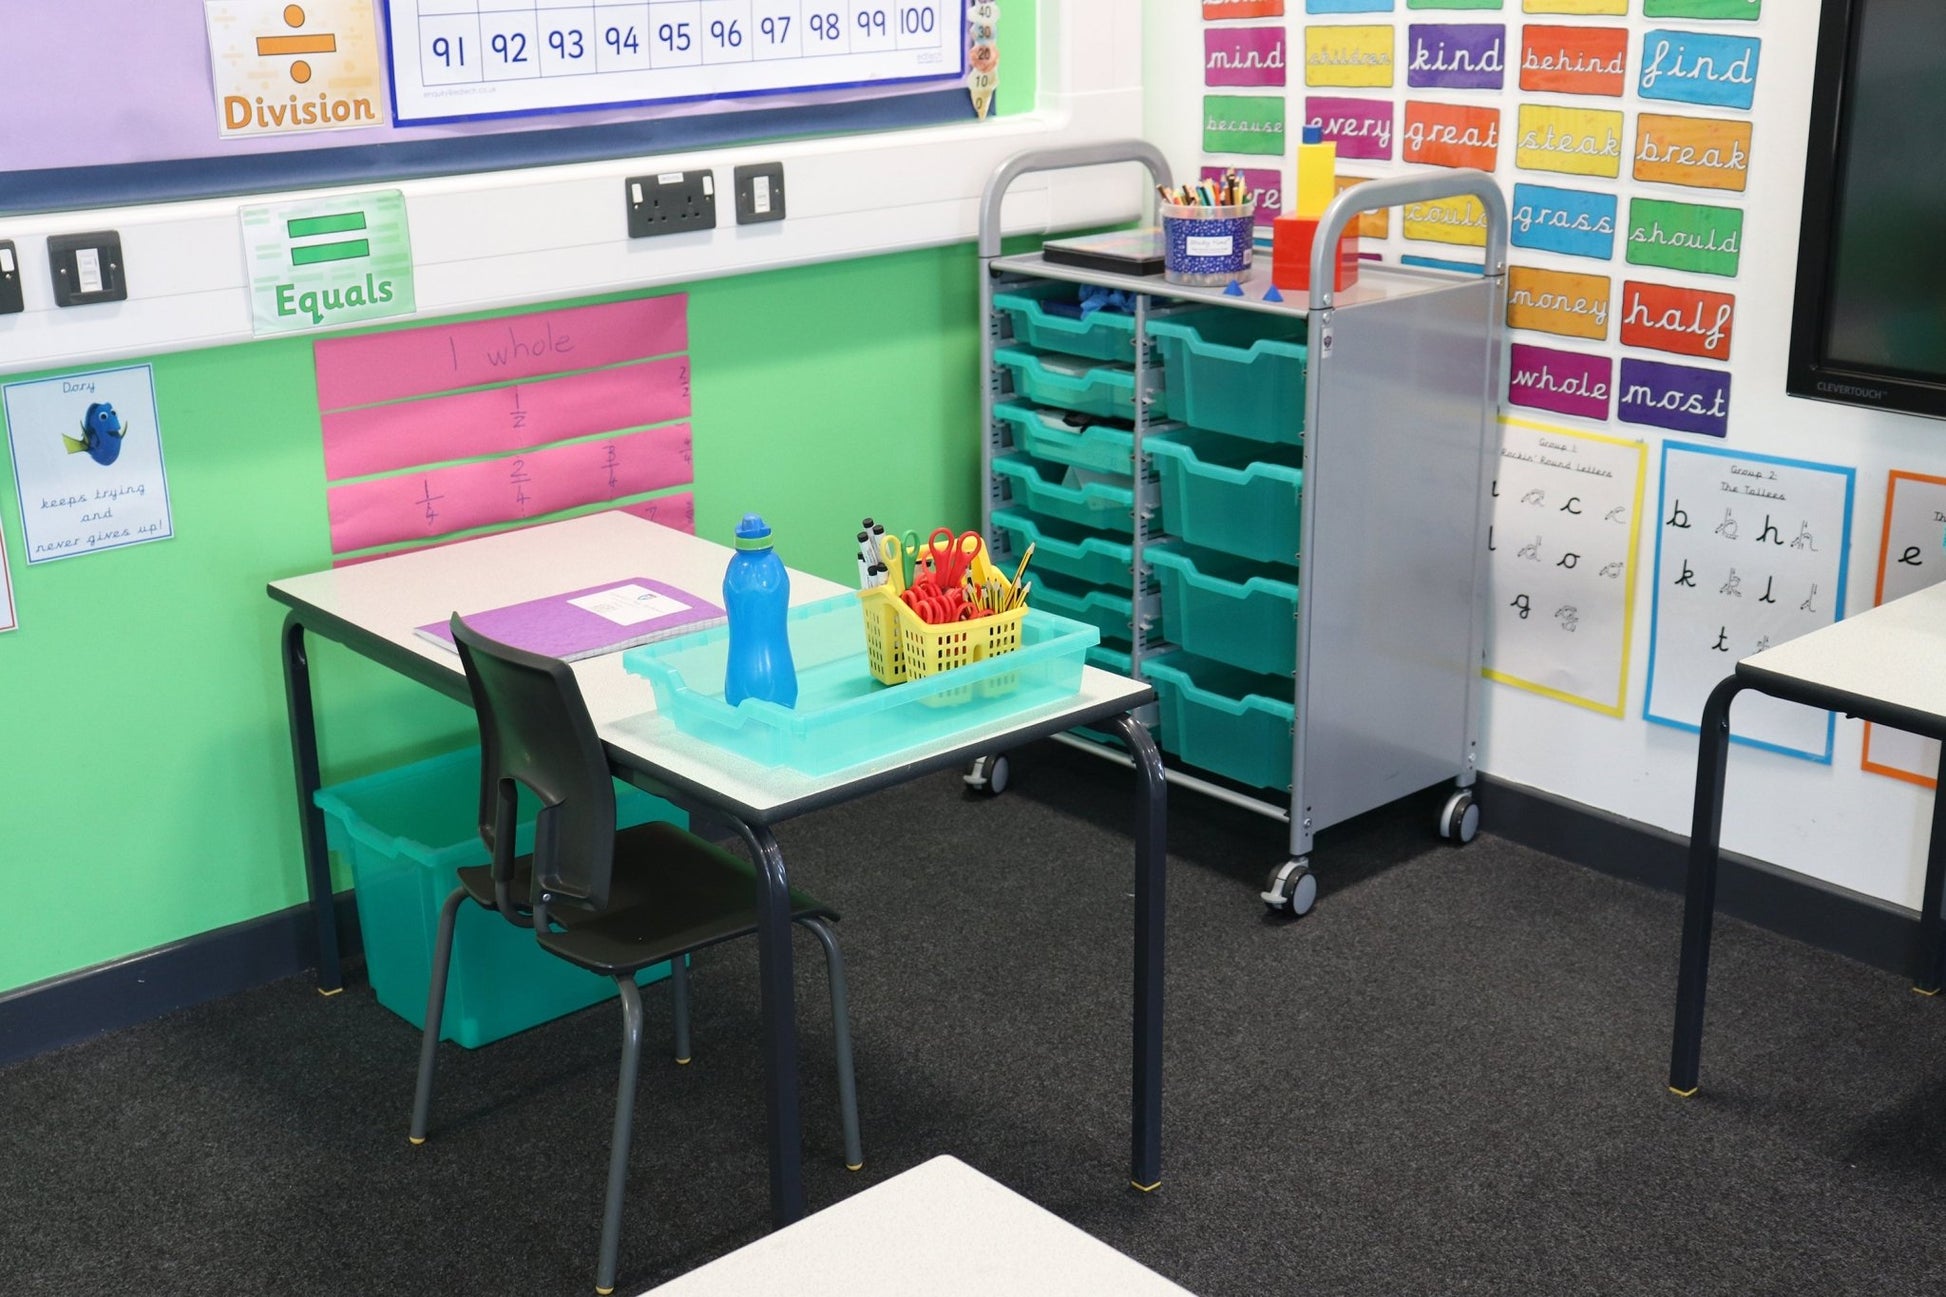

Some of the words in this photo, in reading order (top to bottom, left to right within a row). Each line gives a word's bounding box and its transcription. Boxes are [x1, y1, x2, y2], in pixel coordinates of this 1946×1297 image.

[978, 6, 992, 18] 40
[433, 37, 464, 67] 91
[491, 33, 528, 63] 92
[549, 30, 584, 59] 93
[605, 26, 639, 55] 94
[659, 23, 691, 51] 95
[711, 19, 742, 47] 96
[761, 16, 791, 43] 97
[810, 13, 840, 40] 98
[857, 10, 886, 37] 99
[900, 7, 935, 34] 100
[978, 26, 992, 38] 30
[978, 47, 991, 60] 20
[1206, 41, 1284, 69] mind
[1308, 47, 1391, 65] children
[1409, 37, 1504, 71] kind
[1521, 48, 1624, 75] behind
[1641, 40, 1753, 88] find
[976, 75, 989, 87] 10
[224, 92, 376, 131] Division
[1206, 115, 1284, 132] because
[1404, 121, 1498, 151] great
[1518, 124, 1620, 157] steak
[1636, 133, 1747, 170] break
[1514, 205, 1614, 234] grass
[1629, 222, 1738, 253] should
[275, 273, 394, 325] Equals
[1509, 289, 1608, 325] money
[1623, 292, 1732, 350] half
[486, 321, 576, 369] whole
[62, 381, 96, 394] Dory
[1512, 365, 1609, 401] whole
[1816, 381, 1882, 400] CLEVERTOUCH
[1621, 383, 1727, 418] most
[1538, 437, 1567, 451] Group
[1730, 465, 1762, 480] Group
[40, 494, 87, 509] keeps
[94, 484, 146, 501] trying
[1719, 481, 1739, 493] The
[80, 507, 113, 522] and
[1666, 499, 1691, 529] b
[1756, 514, 1784, 545] h
[35, 538, 80, 553] never
[86, 528, 131, 546] gives
[137, 520, 162, 535] up!
[1897, 546, 1923, 566] e
[1674, 559, 1697, 587] k
